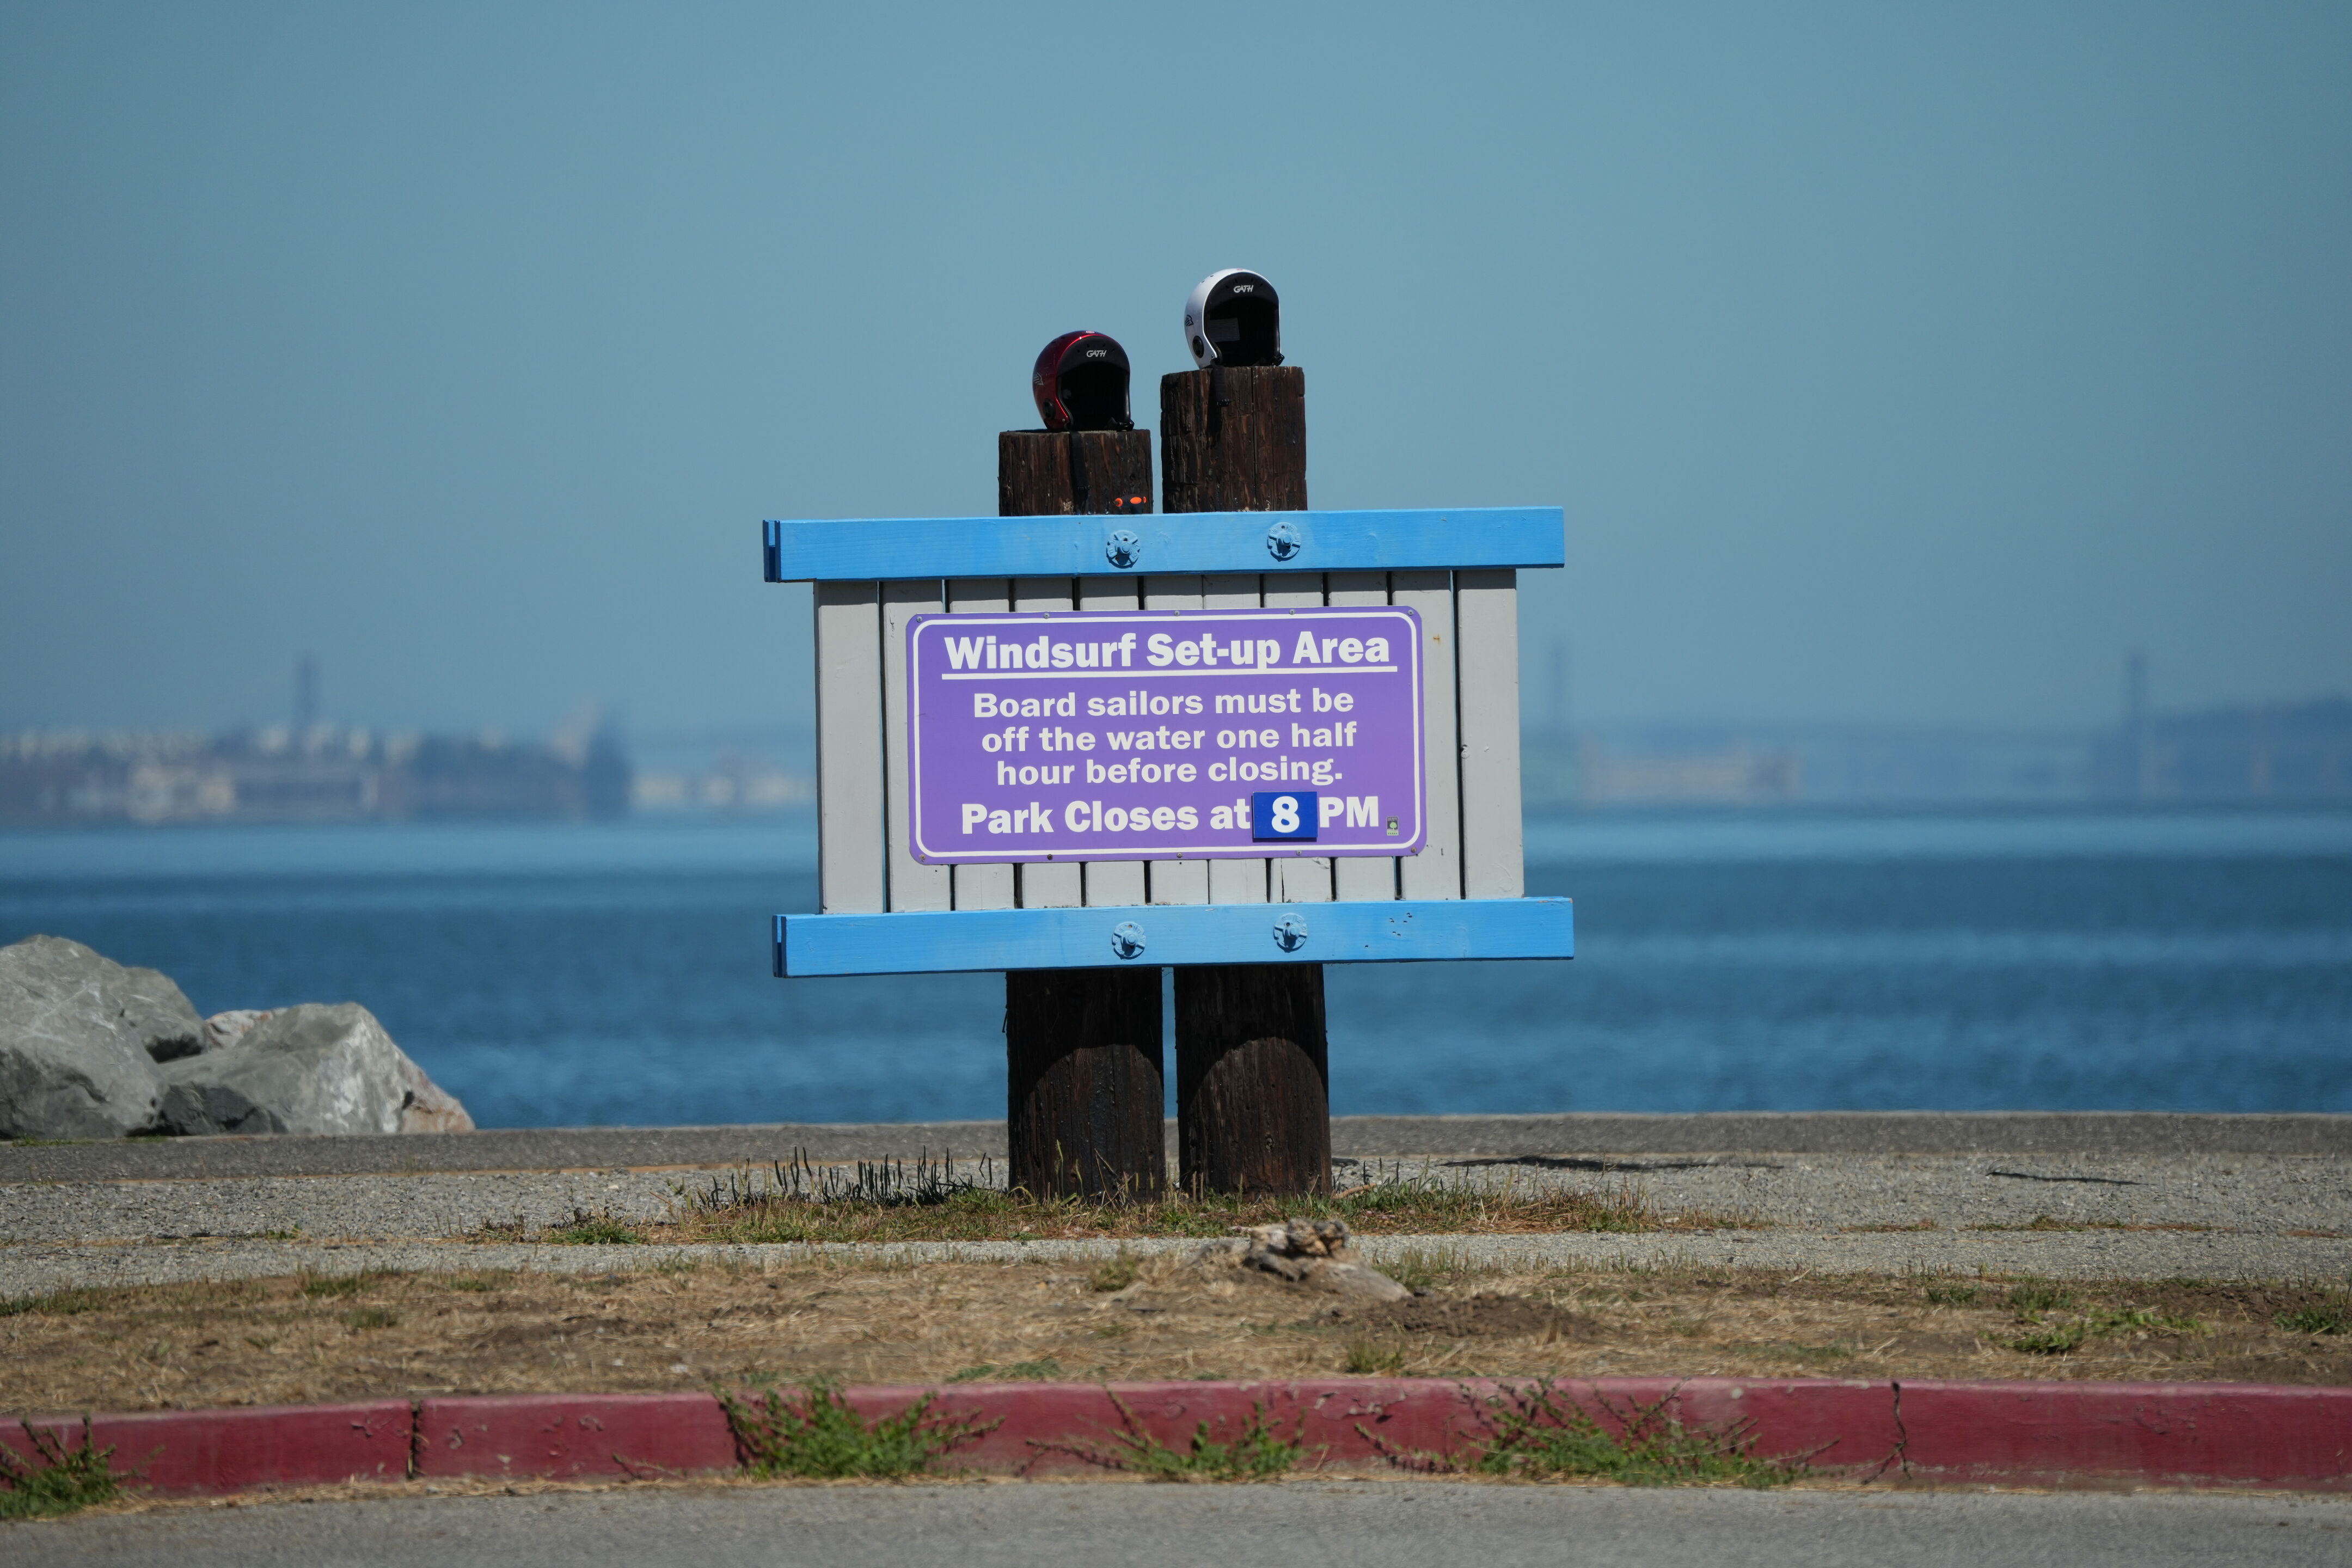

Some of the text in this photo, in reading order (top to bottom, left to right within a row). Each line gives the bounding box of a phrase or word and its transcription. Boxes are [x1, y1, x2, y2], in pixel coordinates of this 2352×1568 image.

[1234, 285, 1254, 293] GATH
[944, 631, 1389, 670] Windsurf Set-up Area
[974, 688, 1354, 718] Board sailors must be
[982, 721, 1357, 752] off the water one half
[997, 755, 1343, 786] hour before closing.
[961, 796, 1379, 834] Park Closes at 8 PM
